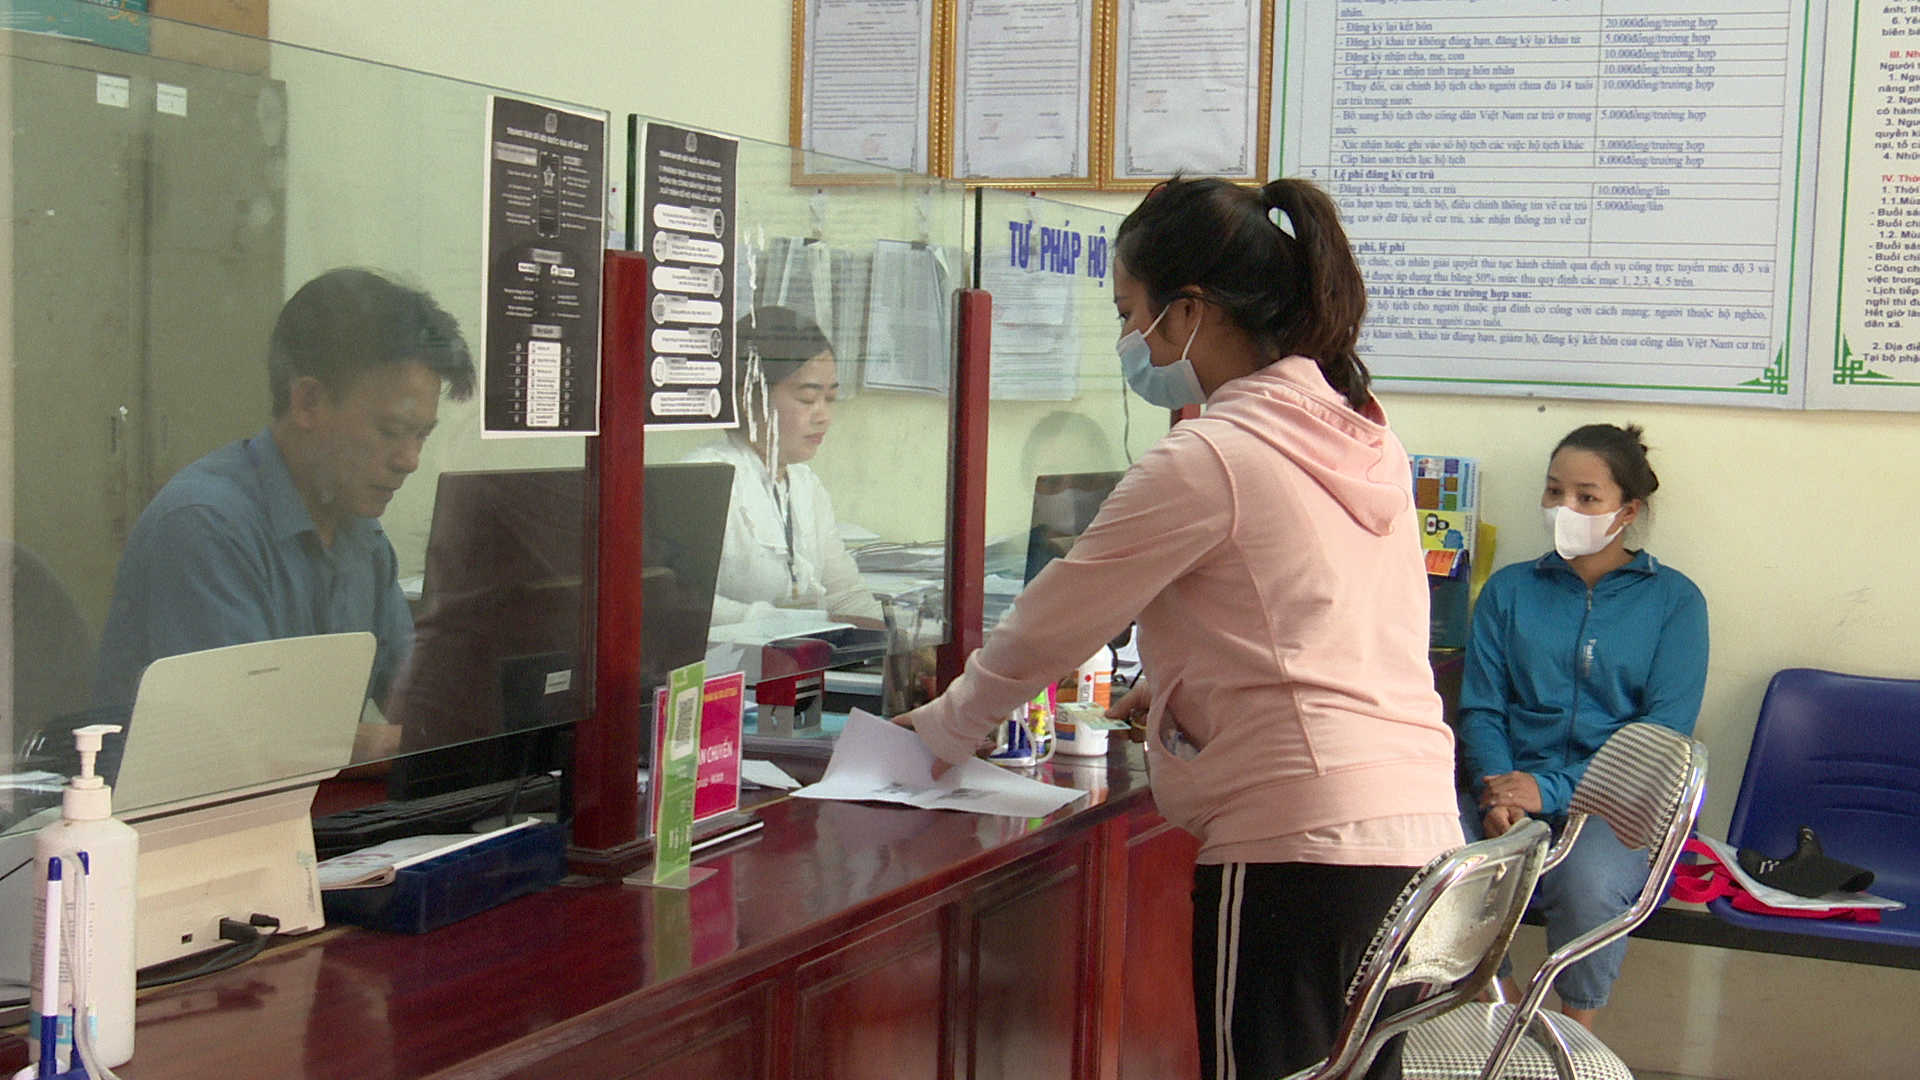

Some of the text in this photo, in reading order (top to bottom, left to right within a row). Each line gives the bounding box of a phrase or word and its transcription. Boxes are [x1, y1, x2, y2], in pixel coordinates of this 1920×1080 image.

[1892, 17, 1900, 25] 6.
[1880, 62, 1915, 72] Người
[1889, 74, 1897, 82] 1.
[1887, 97, 1896, 105] 2.
[1882, 186, 1890, 194] 1.
[1878, 208, 1903, 216] Buổi
[1877, 219, 1902, 227] Buổi
[1876, 241, 1901, 250] Buổi
[1009, 220, 1107, 288] TƯ PHÁP HỘ
[1875, 252, 1900, 261] Buổi
[1874, 264, 1904, 274] Công
[1867, 276, 1889, 284] việc
[1873, 287, 1896, 295] Lịch
[1865, 308, 1884, 318] Hết
[1872, 343, 1882, 351] 2.
[1864, 353, 1879, 362] Tại
[1882, 354, 1896, 363] bộ
